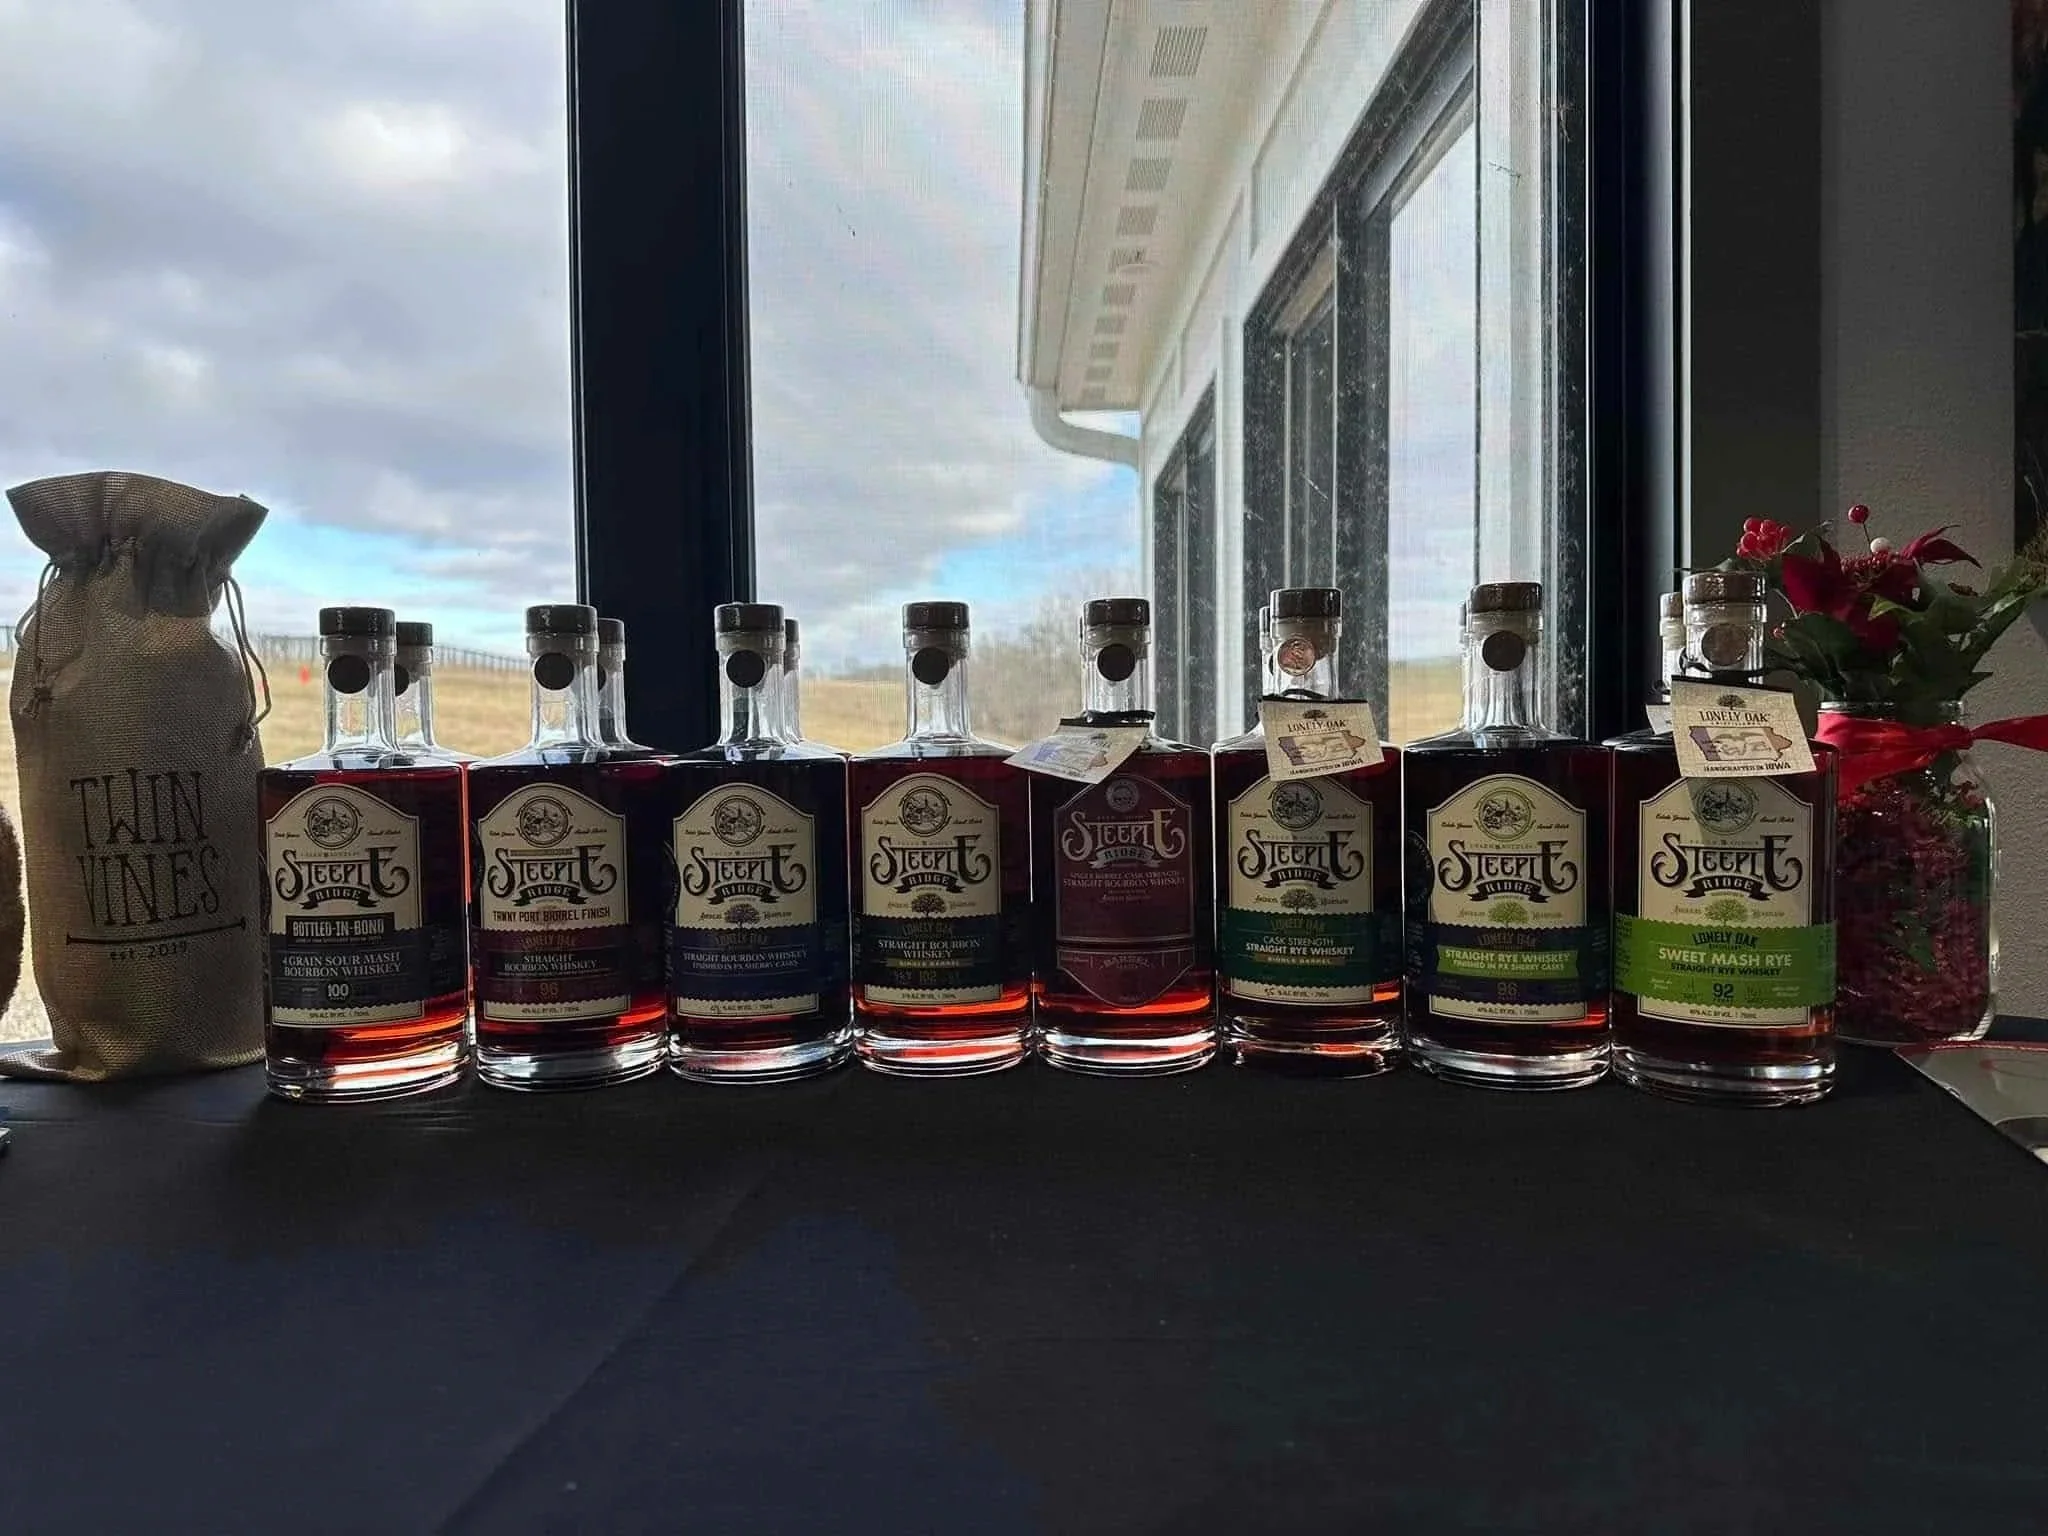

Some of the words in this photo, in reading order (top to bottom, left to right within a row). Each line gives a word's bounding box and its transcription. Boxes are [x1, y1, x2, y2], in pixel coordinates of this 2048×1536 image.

[1698, 711, 1741, 722] LONELY
[1743, 711, 1768, 723] OAK
[1287, 720, 1323, 733] LONELY
[1325, 719, 1347, 729] OAK
[1341, 757, 1364, 767] IOWA
[1765, 761, 1791, 770] IOWA
[70, 768, 203, 849] TWIN
[1062, 807, 1186, 862] STEEPLE
[870, 834, 992, 885] STEEPLE
[1238, 829, 1365, 881] STEEPLE
[1650, 832, 1804, 892] STEEPLE
[275, 846, 410, 901] STEEPLE
[487, 844, 618, 898] STEEPLE
[683, 843, 807, 896] STEEPLE
[1438, 840, 1578, 894] STEEPLE
[76, 846, 220, 927] VINES
[1486, 882, 1532, 895] RIDGE
[1702, 877, 1754, 891] RIDGE
[519, 910, 541, 922] PORT
[581, 907, 611, 921] FINISH
[292, 919, 386, 937] BOTTLED-IN-BOND
[1263, 936, 1285, 945] CASK
[1287, 936, 1334, 947] STRENGTH
[1692, 931, 1733, 946] LONELY
[1735, 932, 1760, 947] OAK
[1245, 943, 1288, 955] STRAIGHT
[1290, 946, 1308, 956] RYE
[1310, 946, 1355, 956] WHISKEY
[1445, 950, 1495, 962] STRAIGHT
[1497, 953, 1518, 962] RYE
[1520, 953, 1570, 963] WHISKEY
[325, 954, 361, 967] SOUR
[363, 952, 401, 965] MASH
[1659, 948, 1707, 965] SWEET
[1712, 953, 1761, 967] MASH
[1765, 954, 1793, 968] RYE
[284, 965, 339, 978] BOURBON
[341, 962, 402, 977] WHISKEY
[1671, 962, 1717, 975] STRAIGHT
[1719, 966, 1737, 976] RYE
[1739, 967, 1782, 977] WHISKEY
[327, 983, 350, 997] 100
[1712, 983, 1734, 998] 92
